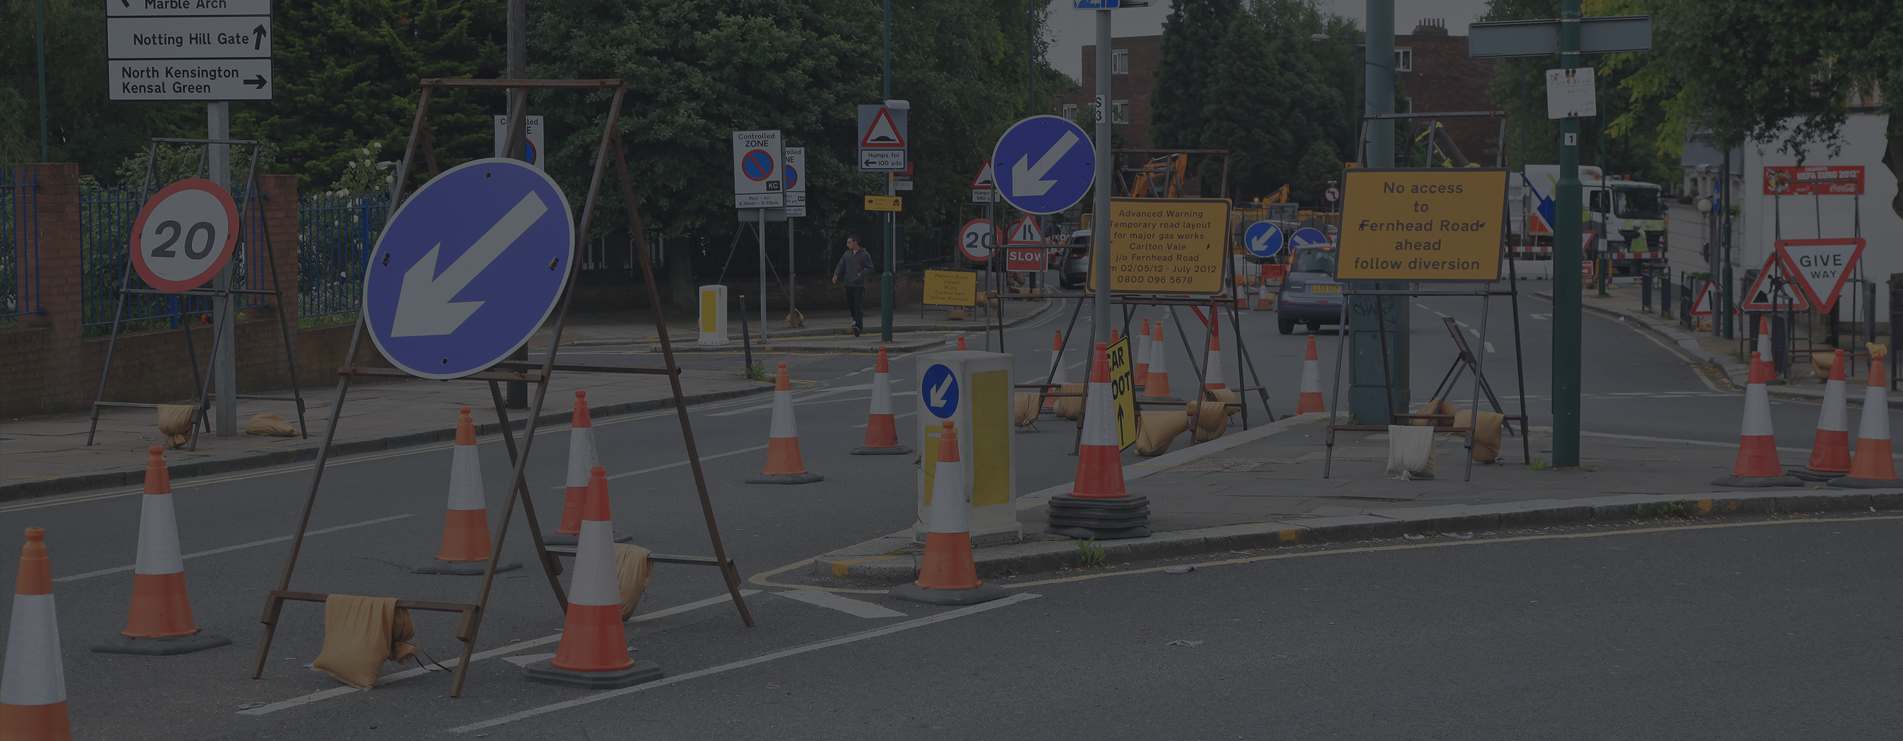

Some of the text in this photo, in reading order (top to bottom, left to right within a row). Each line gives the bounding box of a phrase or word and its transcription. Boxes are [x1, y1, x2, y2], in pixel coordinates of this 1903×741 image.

[145, 0, 226, 9] Marble Arch
[133, 32, 249, 47] Notting Hill Gate
[122, 66, 239, 80] North Kensington
[122, 82, 211, 94] Kensal Green
[738, 132, 775, 140] Controlled
[744, 140, 769, 148] ZONE
[1384, 182, 1464, 194] No access
[1414, 201, 1429, 213] to
[1119, 209, 1204, 219] Advanced Warning
[1160, 221, 1180, 229] road
[1183, 221, 1211, 229] layout
[1359, 219, 1481, 232] Fernhead Road
[151, 220, 216, 260] 20
[1113, 231, 1204, 241] for major gas works
[1129, 242, 1187, 250] Carlton Vale
[1394, 239, 1441, 251] ahead
[1131, 253, 1173, 261] Fernhead
[1176, 253, 1200, 261] Road
[1800, 254, 1843, 267] GIVE
[1354, 256, 1480, 270] follow diversion
[1172, 264, 1191, 274] July
[1194, 265, 1217, 273] 2012
[1810, 270, 1836, 279] WAY
[1117, 276, 1145, 284] 0800
[1111, 372, 1130, 400] OOT
